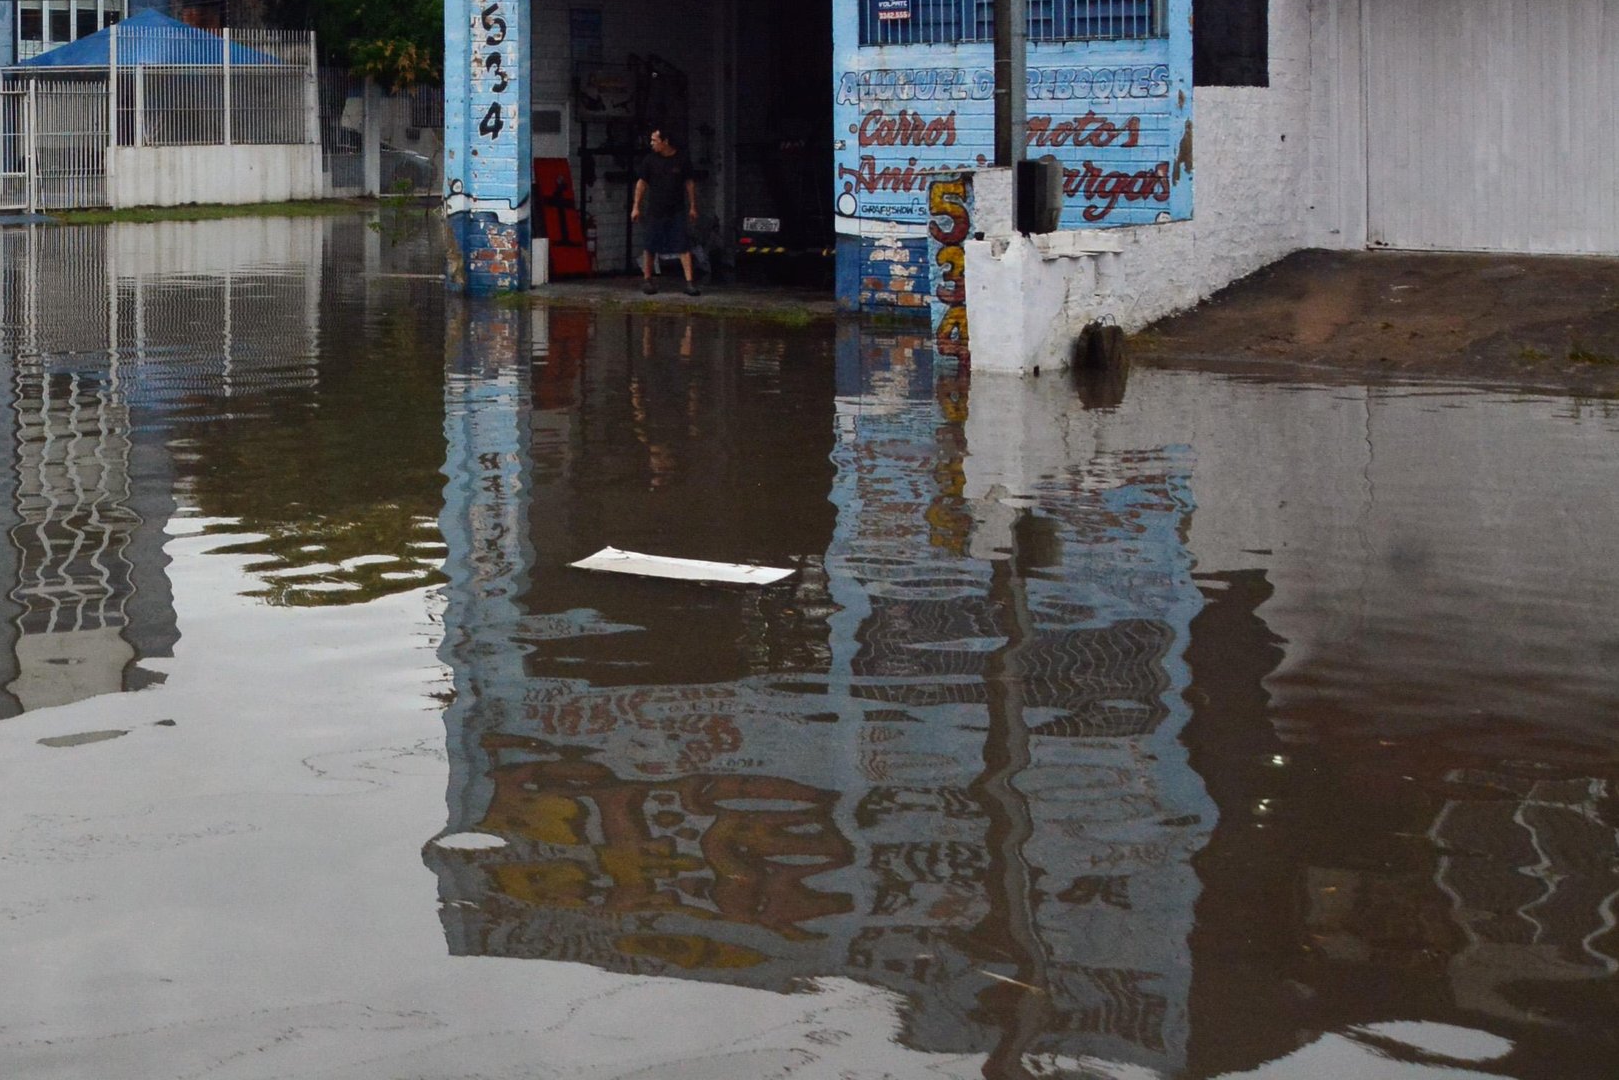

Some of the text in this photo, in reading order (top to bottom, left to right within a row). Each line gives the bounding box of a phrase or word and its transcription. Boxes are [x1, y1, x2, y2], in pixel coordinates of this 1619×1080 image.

[837, 68, 967, 106] ALUGUEL
[972, 69, 995, 100] D
[858, 109, 957, 147] Carros
